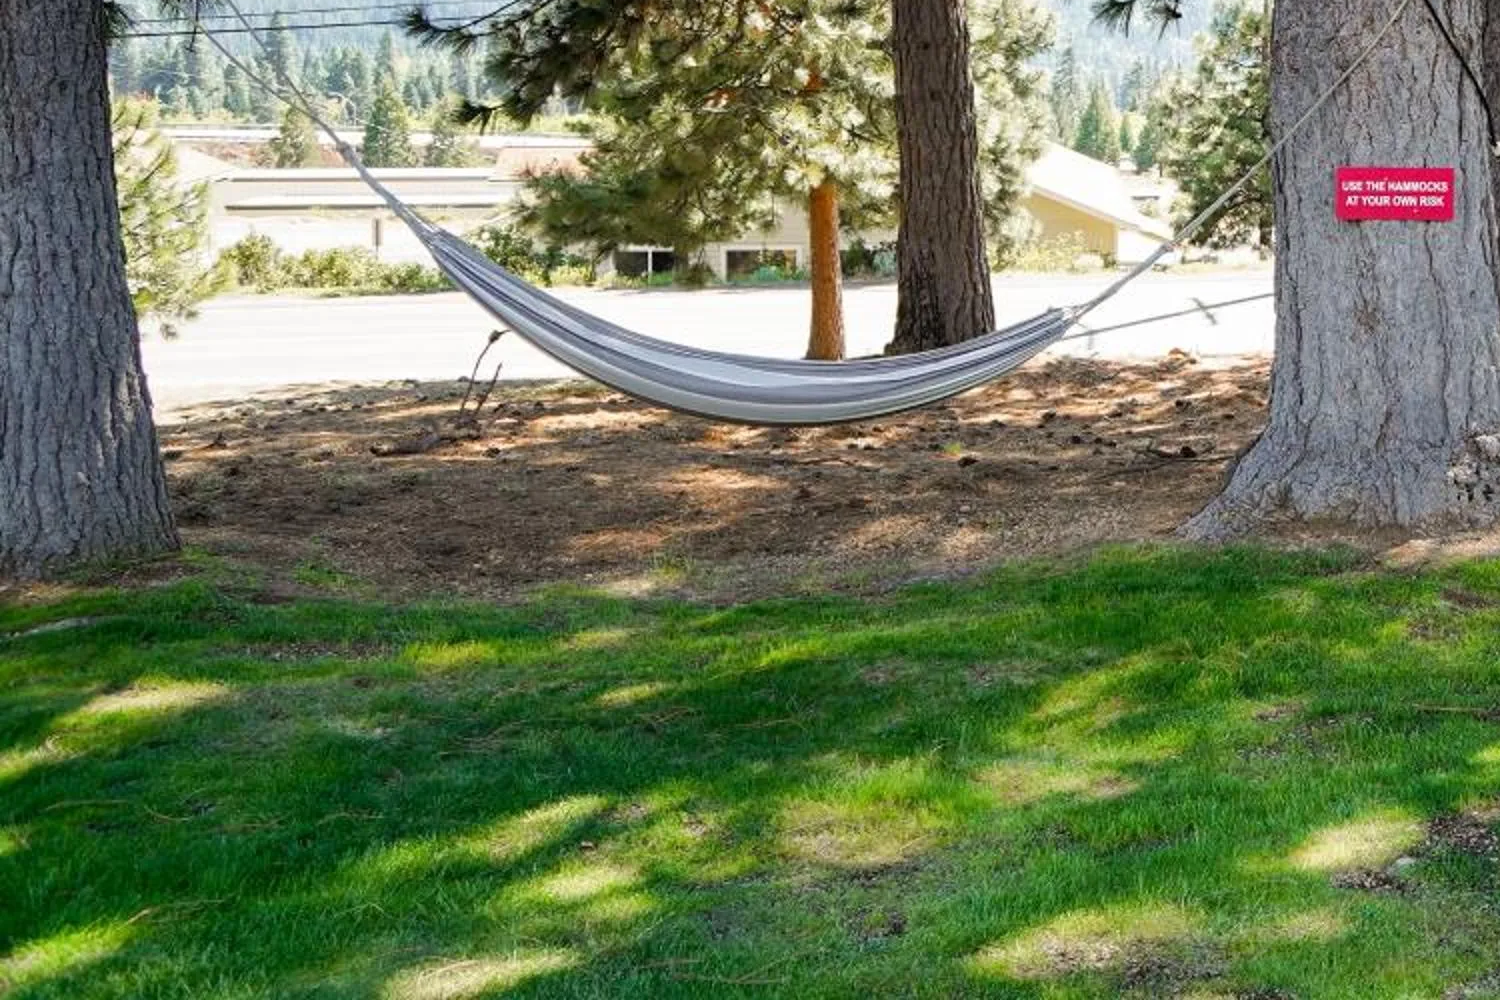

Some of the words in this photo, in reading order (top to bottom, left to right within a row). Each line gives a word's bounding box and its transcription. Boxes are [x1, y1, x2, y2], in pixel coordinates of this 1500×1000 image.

[1341, 181, 1363, 191] USE
[1366, 181, 1386, 191] THE
[1388, 181, 1448, 192] HAMMOCKS
[1345, 195, 1359, 206] AT
[1361, 195, 1391, 206] YOUR
[1392, 195, 1417, 206] OWN
[1419, 195, 1445, 207] RISK
